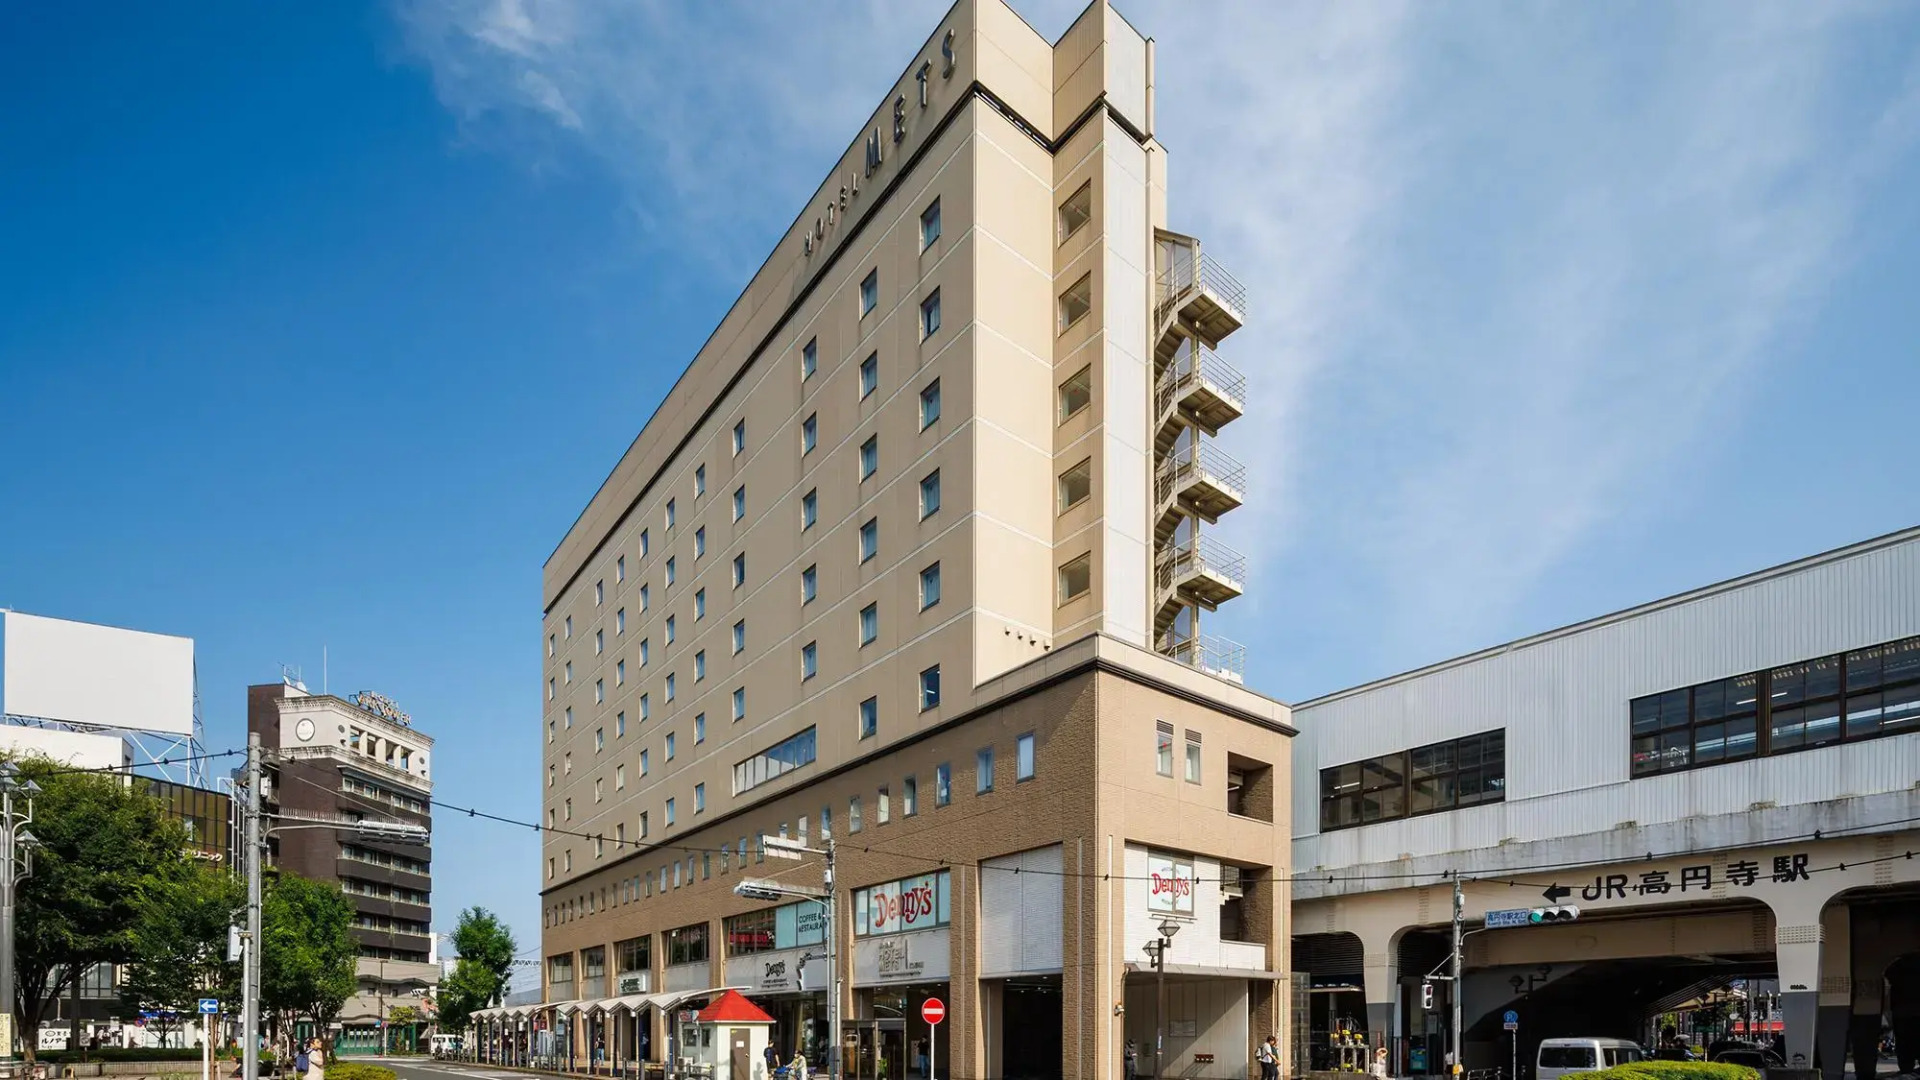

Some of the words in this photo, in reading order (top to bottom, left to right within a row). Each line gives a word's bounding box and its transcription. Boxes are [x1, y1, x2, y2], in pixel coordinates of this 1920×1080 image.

[804, 172, 858, 257] HOTEL
[865, 28, 956, 178] METS
[1151, 873, 1190, 898] Denny's
[799, 913, 817, 924] COFFEE
[818, 912, 821, 920] &
[875, 880, 932, 928] Denny's
